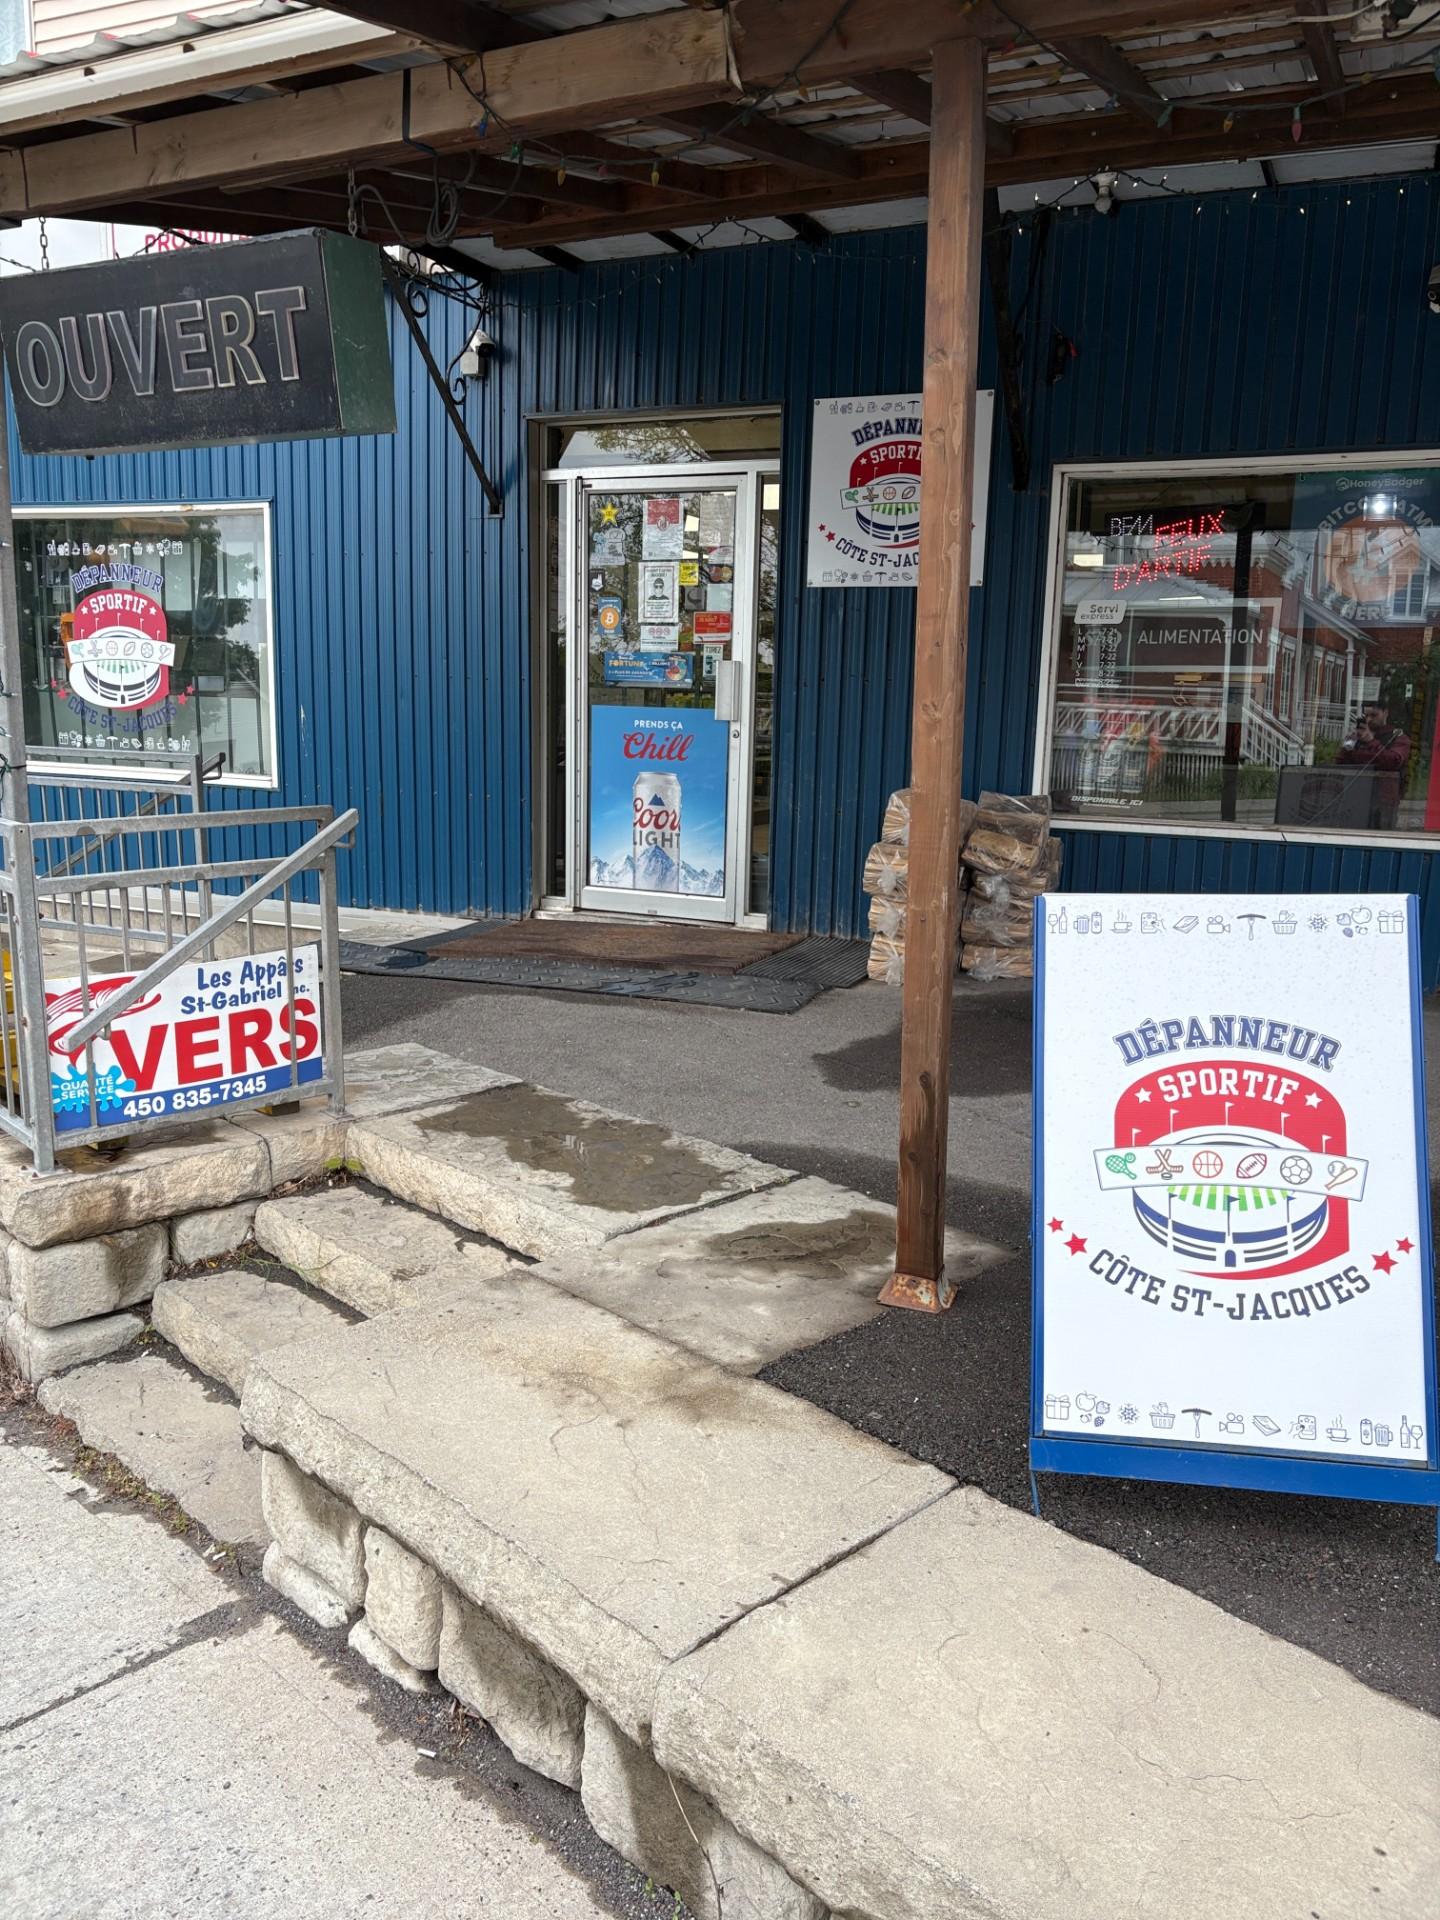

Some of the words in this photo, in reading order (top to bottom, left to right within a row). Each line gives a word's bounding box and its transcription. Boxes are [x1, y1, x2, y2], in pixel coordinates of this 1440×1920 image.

[16, 286, 307, 407] OUVERT
[851, 417, 922, 446] DÉPANN
[1154, 509, 1225, 552] FEUX
[835, 538, 868, 563] CÔTE
[869, 552, 919, 568] ST-JAC
[1113, 543, 1212, 591] D'ARTIF
[71, 562, 164, 594] DÉPANNEUR
[89, 593, 148, 614] SPORTIF
[1089, 603, 1119, 614] Servi
[1137, 628, 1264, 645] ALIMENTATION
[67, 695, 98, 725] CÔTE
[101, 701, 177, 732] ST-JACQUES
[634, 719, 669, 729] PRENDS
[671, 720, 683, 732] ÇA
[623, 731, 695, 761] Chill
[197, 968, 232, 990] Les
[240, 956, 303, 987] Appâs
[181, 981, 282, 1014] St-Gabriel
[110, 998, 318, 1092] VERS
[1112, 1015, 1342, 1072] DÉPANNEUR
[61, 1074, 114, 1091] QUAITÉ
[124, 1096, 166, 1118] 450
[172, 1076, 267, 1111] 835-7345
[1157, 1068, 1300, 1106] SPORTIF
[1089, 1249, 1166, 1305] CÔTE
[1171, 1265, 1370, 1320] ST-JACQUES
